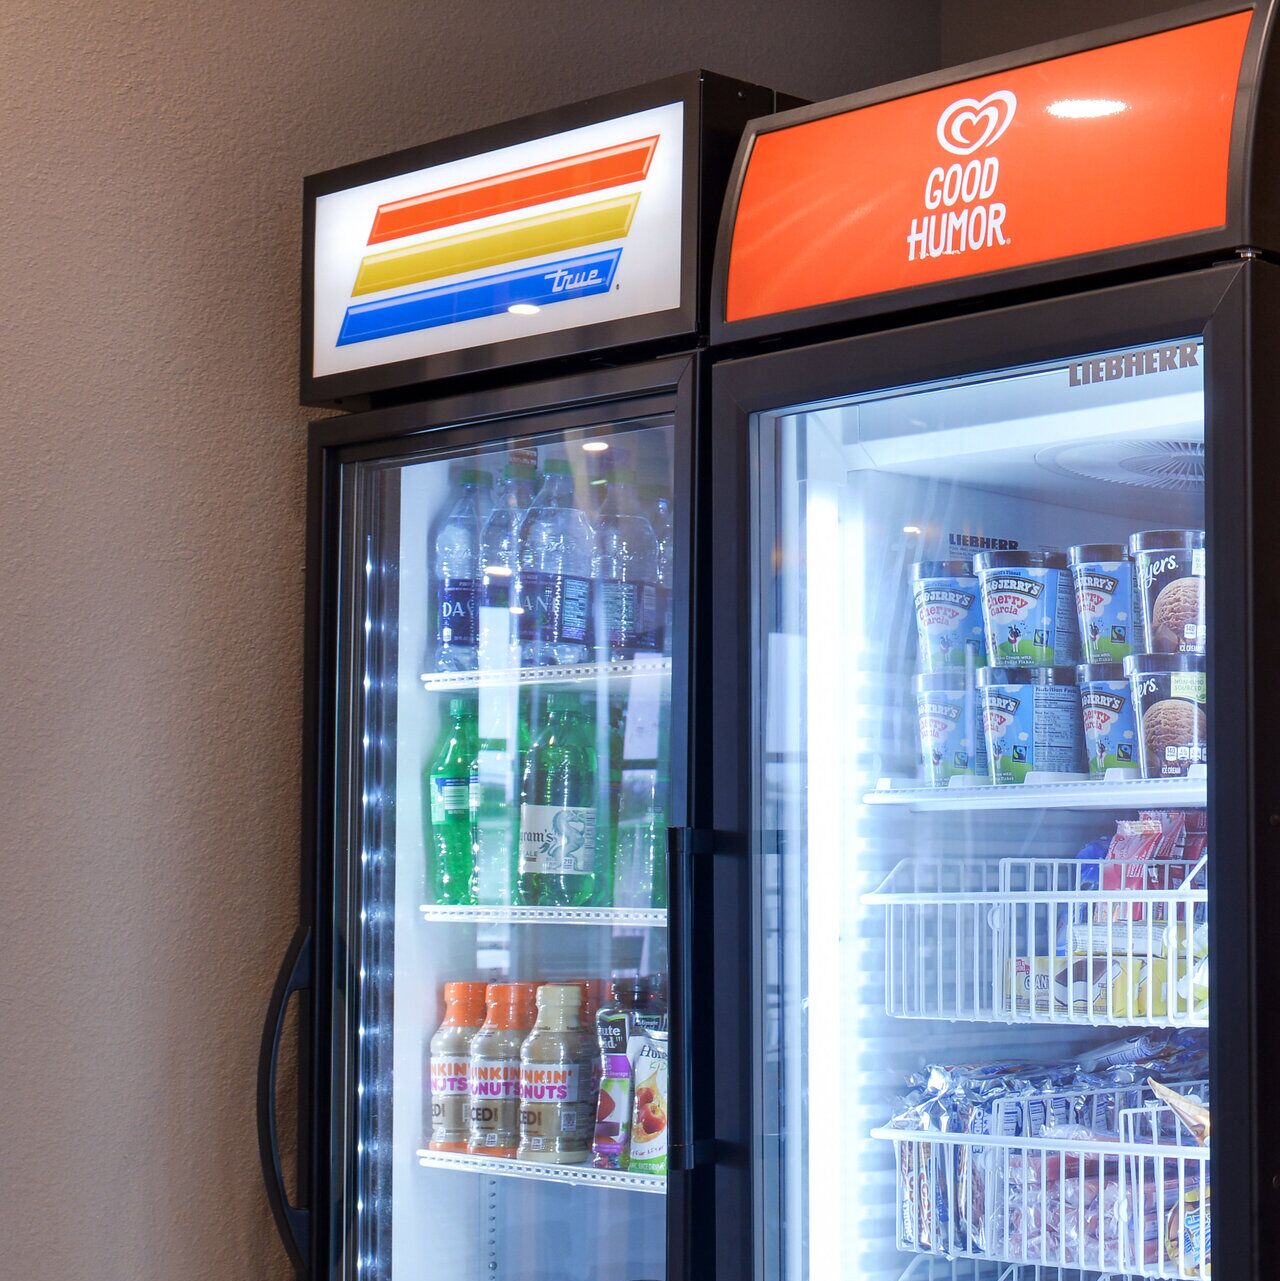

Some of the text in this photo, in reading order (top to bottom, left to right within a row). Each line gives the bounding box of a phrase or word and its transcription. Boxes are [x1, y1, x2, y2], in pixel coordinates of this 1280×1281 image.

[923, 155, 1000, 210] GOOD
[906, 206, 1006, 263] HUMOR
[1067, 343, 1201, 388] LIEBHERR
[949, 532, 1020, 551] LIEBHERR
[987, 594, 1030, 610] Cherry
